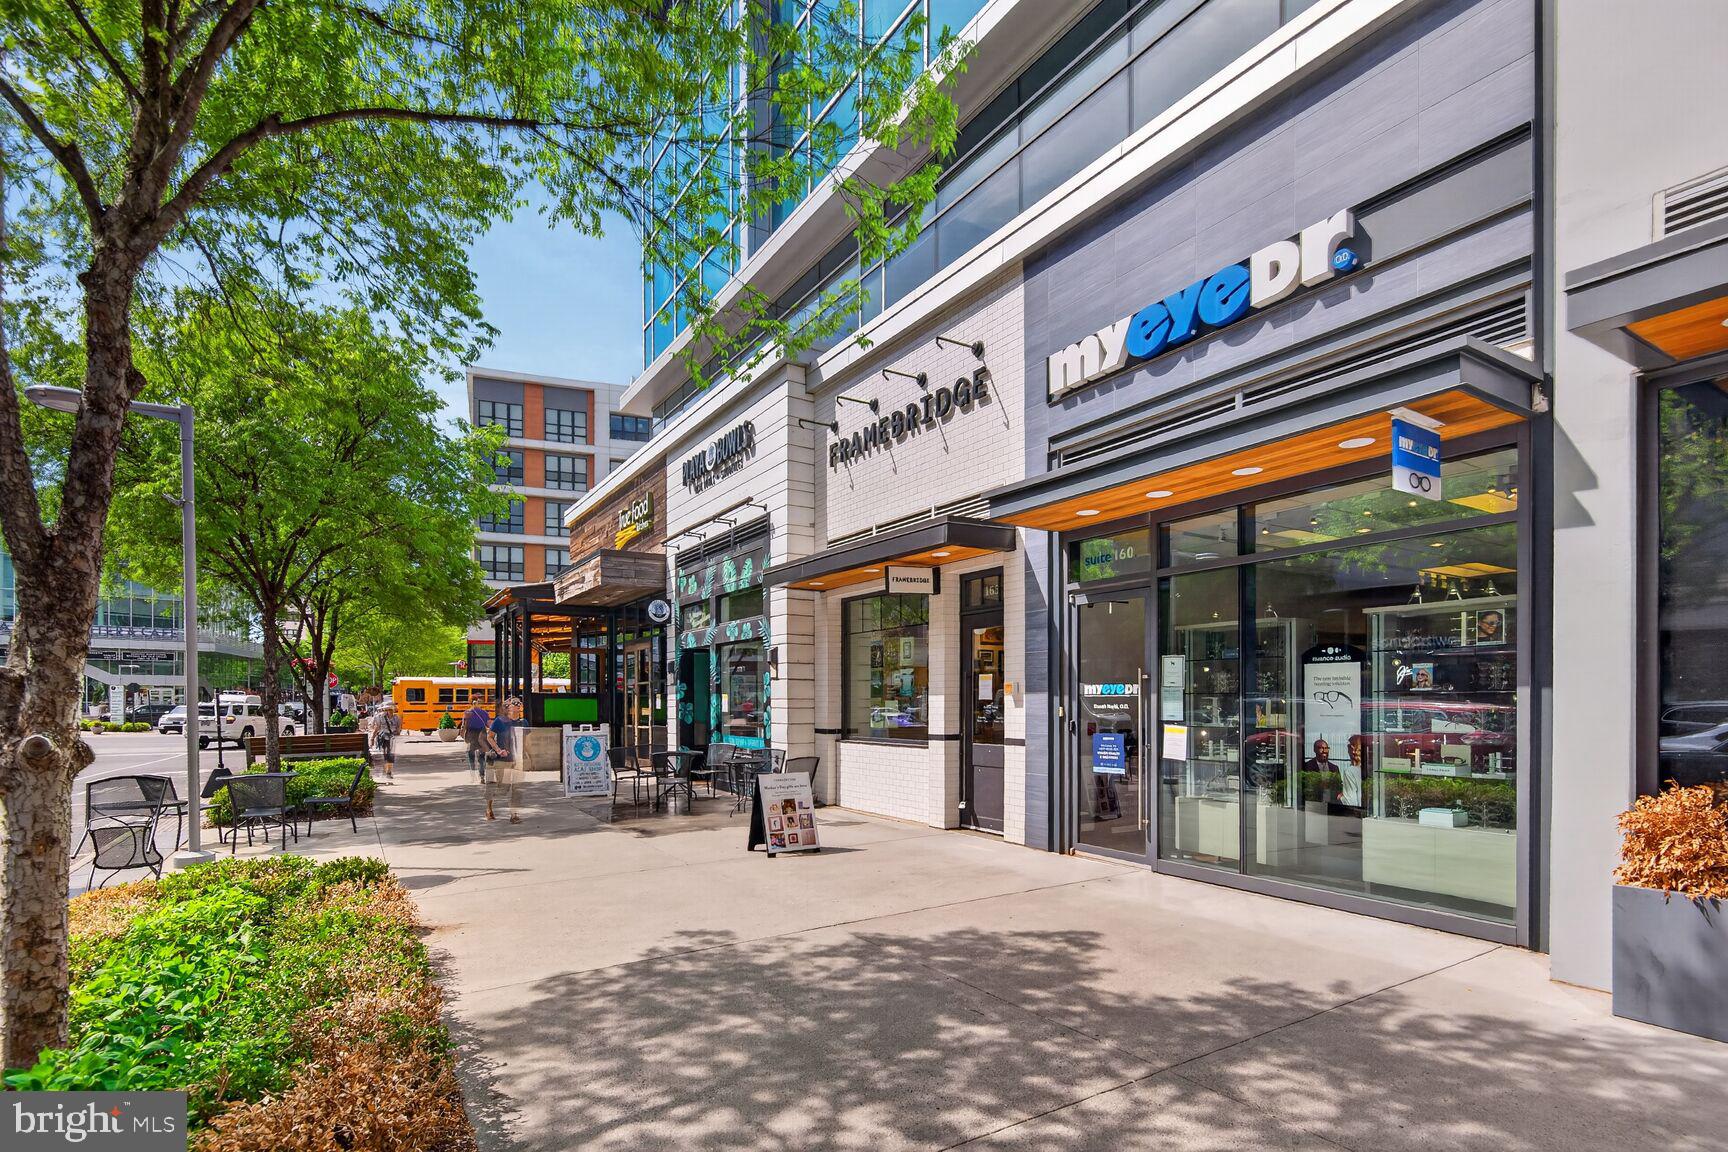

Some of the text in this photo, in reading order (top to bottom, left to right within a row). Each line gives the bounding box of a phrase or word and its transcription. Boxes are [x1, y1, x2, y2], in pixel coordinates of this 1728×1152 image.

[829, 366, 988, 468] FRAMEBRIDGE
[683, 450, 706, 484] PLAYA
[717, 420, 753, 464] BOWLS
[618, 491, 649, 529] True Food
[1114, 546, 1134, 560] 160
[892, 576, 930, 584] FRAMEBRIDGE
[985, 585, 999, 596] 165
